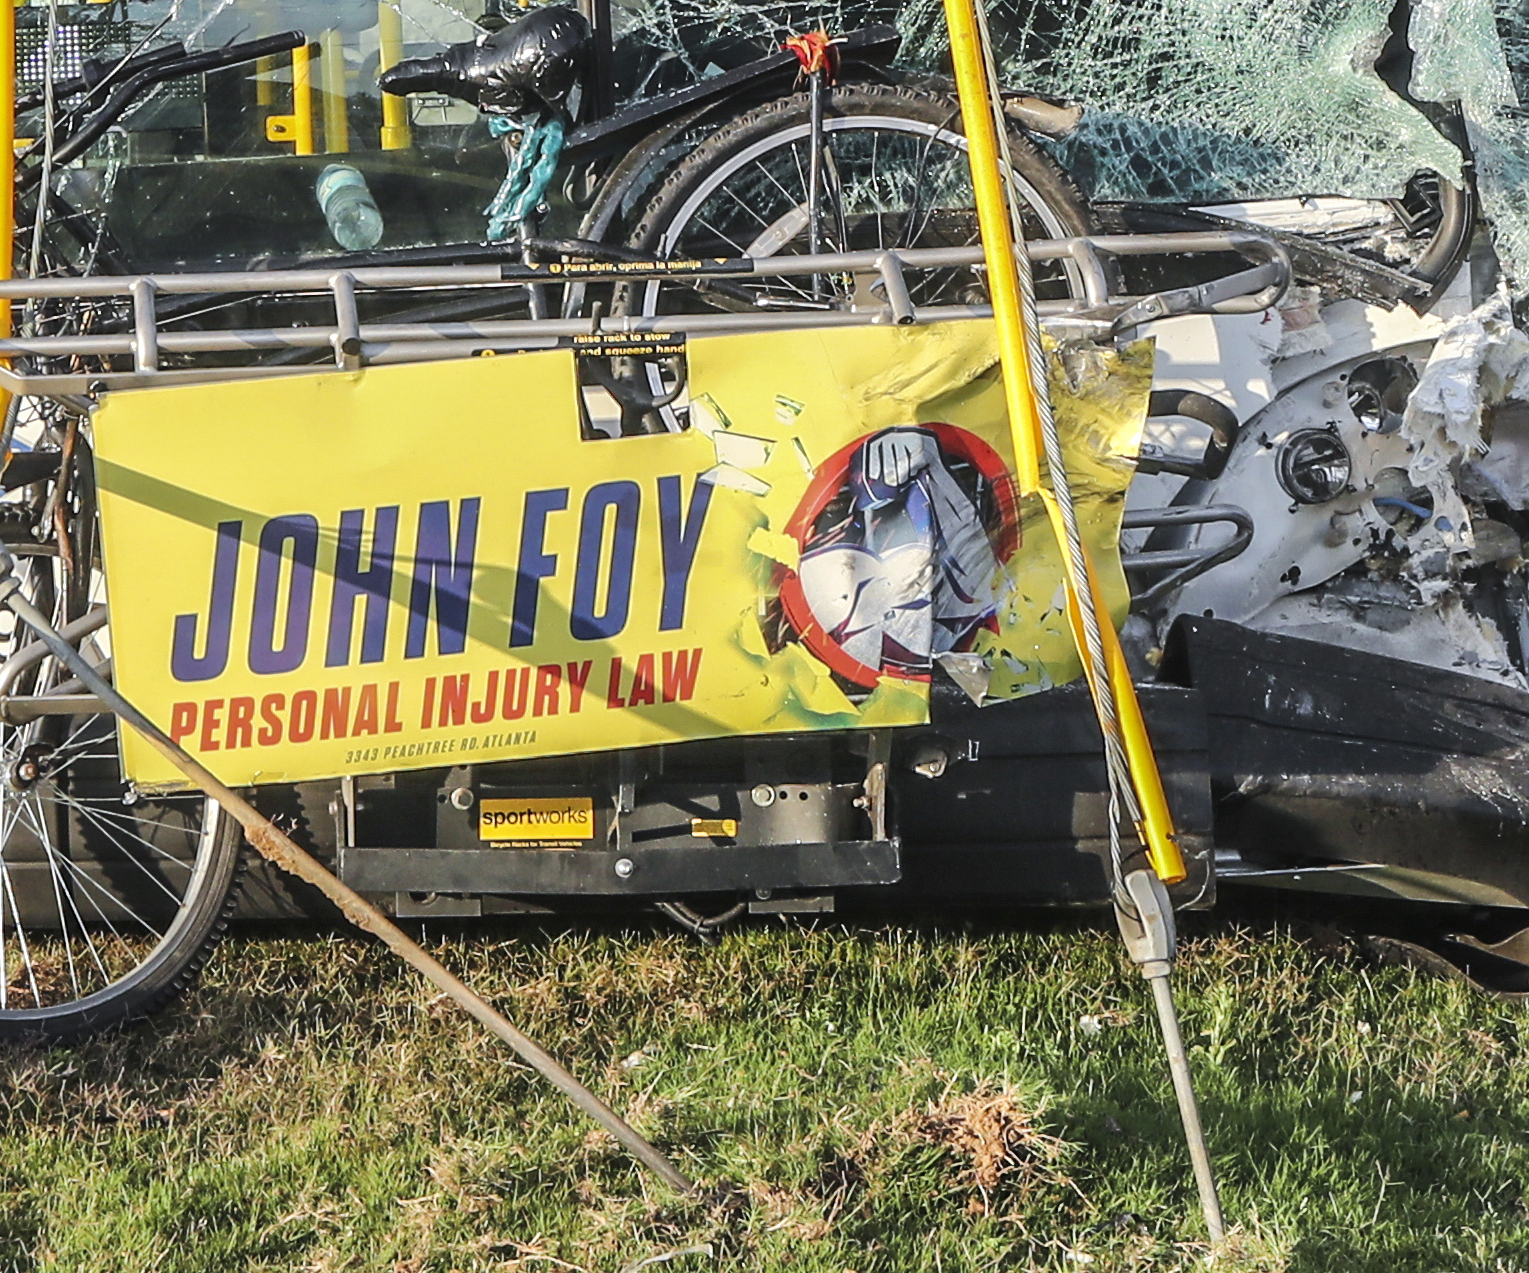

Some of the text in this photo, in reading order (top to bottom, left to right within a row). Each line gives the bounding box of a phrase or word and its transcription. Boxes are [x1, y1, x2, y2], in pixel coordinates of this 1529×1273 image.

[656, 345, 685, 354] hand
[171, 472, 716, 682] JOHN FOY
[171, 647, 703, 752] PERSONAL INJURY LAW
[345, 748, 379, 764] 3343
[383, 739, 456, 760] PEACHTREE
[482, 730, 538, 749] ATLANTA
[482, 807, 588, 828] sportworks
